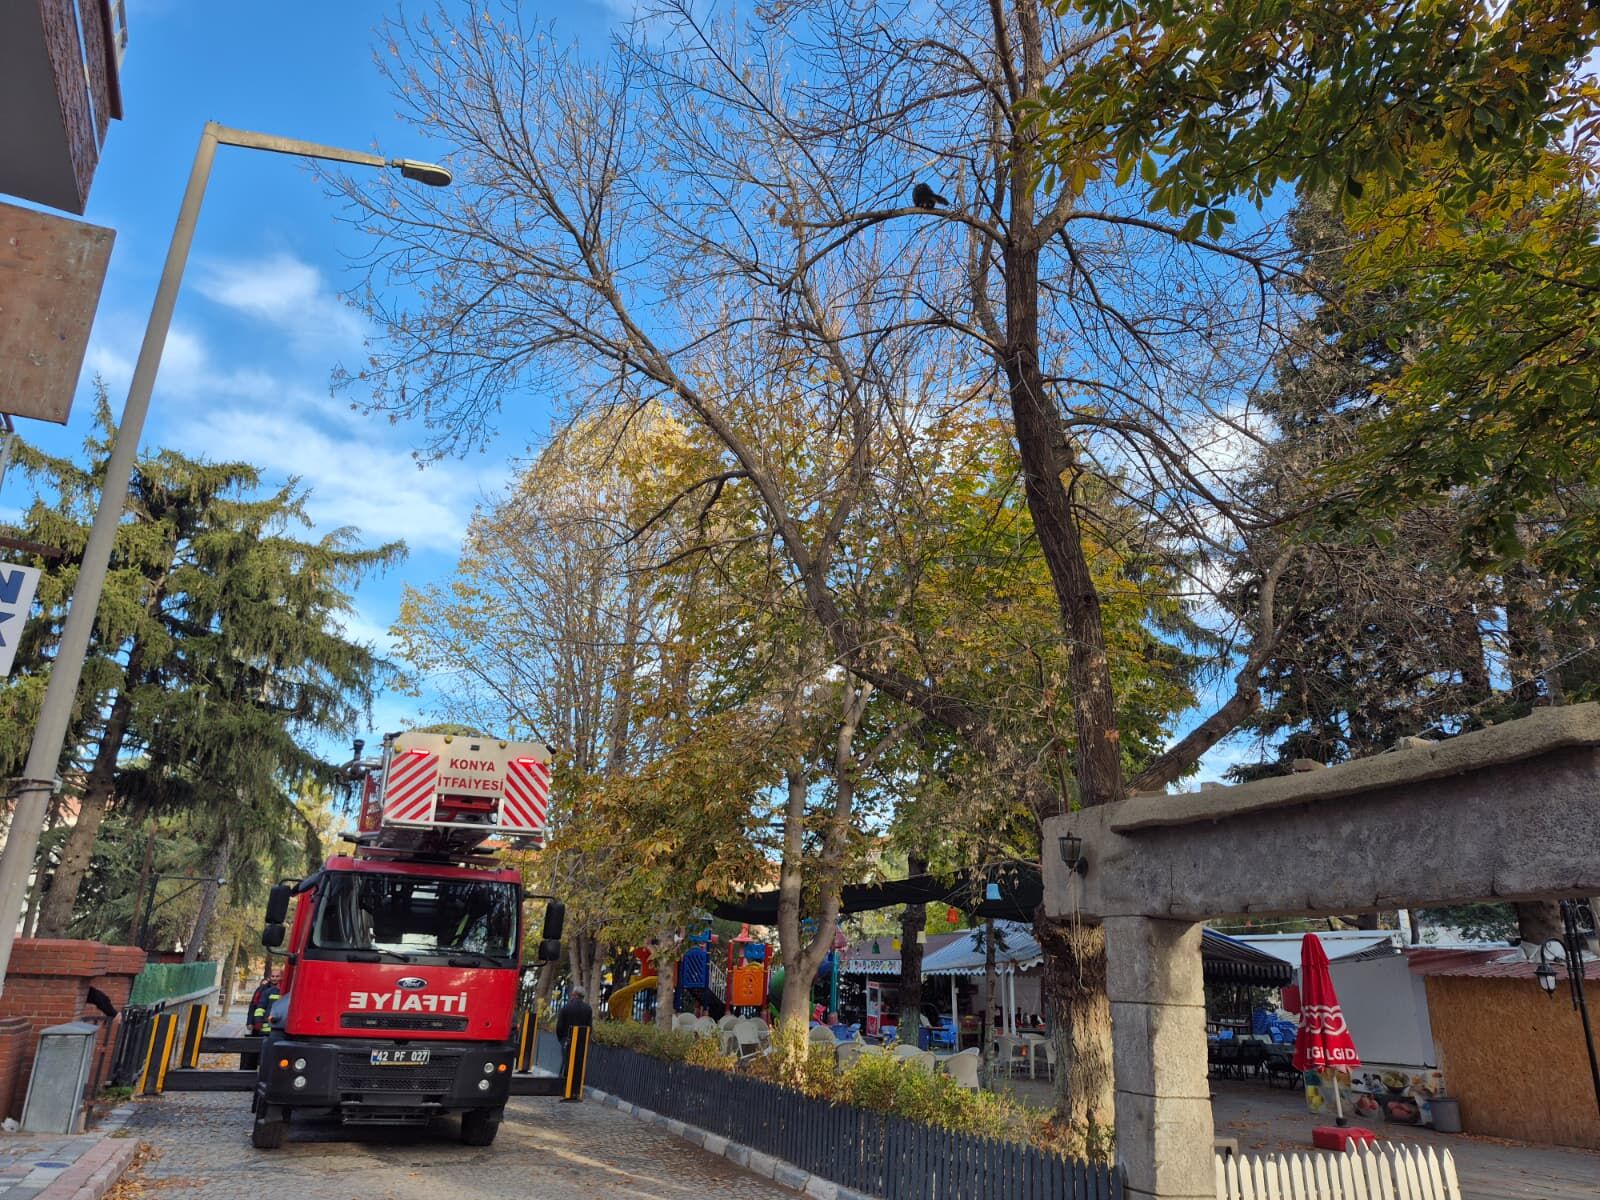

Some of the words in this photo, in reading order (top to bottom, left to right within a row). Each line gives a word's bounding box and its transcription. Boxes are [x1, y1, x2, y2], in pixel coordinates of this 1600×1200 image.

[450, 758, 495, 772] KONYA
[437, 774, 503, 791] İTFAİYESİ
[377, 1051, 389, 1062] 42
[394, 1051, 406, 1062] PF
[411, 1051, 428, 1062] 027
